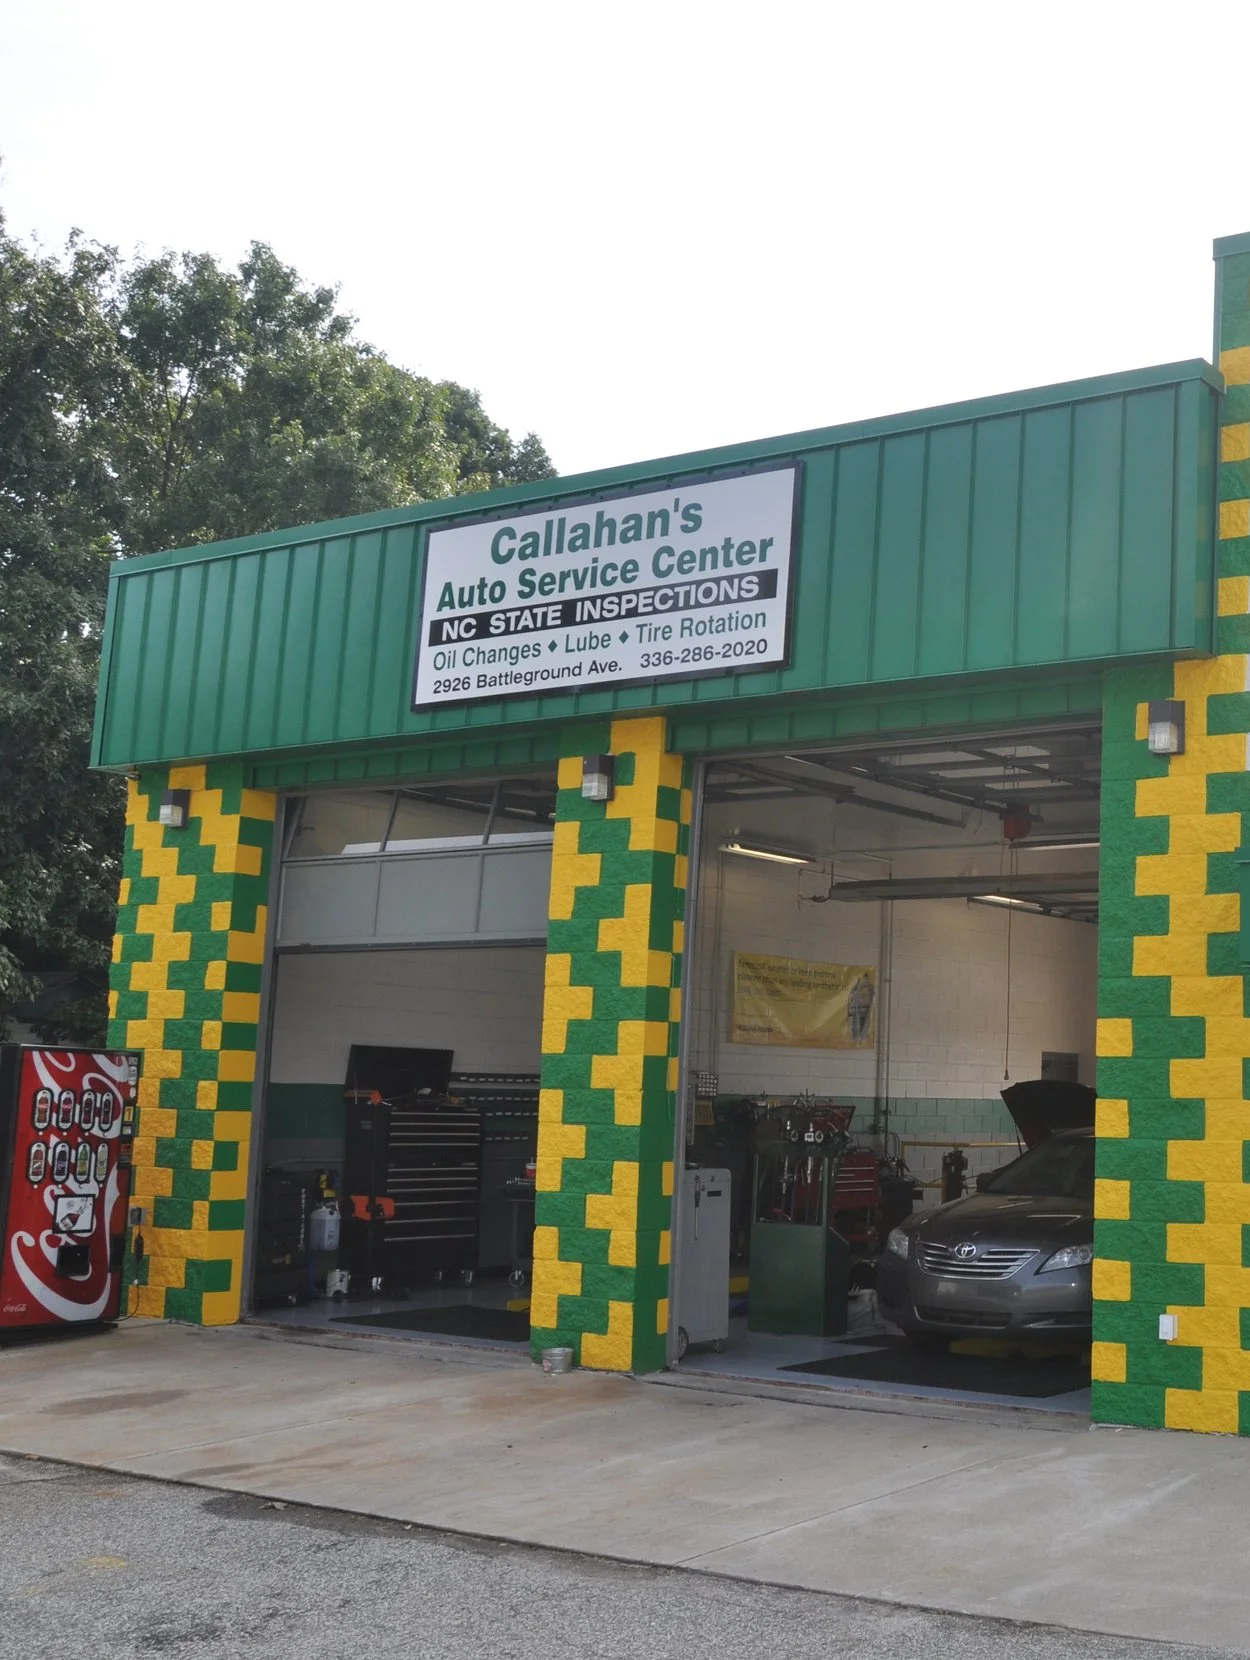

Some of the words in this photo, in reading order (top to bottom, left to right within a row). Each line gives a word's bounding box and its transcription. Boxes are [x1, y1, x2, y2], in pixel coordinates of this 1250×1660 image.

[491, 498, 703, 565] Callahan's
[436, 577, 506, 612] Auto
[517, 556, 639, 600] Service
[652, 537, 774, 579] Center
[433, 650, 456, 671] Oil
[462, 642, 541, 667] Changes
[565, 631, 611, 653] Lube
[636, 623, 672, 644] Tire
[680, 611, 766, 638] Rotation
[442, 618, 477, 641] NC
[489, 605, 563, 635] STATE
[575, 575, 760, 622] INSPECTIONS
[433, 677, 471, 694] 2926
[476, 662, 582, 688] Battleground
[588, 660, 622, 675] Ave.
[640, 638, 768, 669] 336-286-2020
